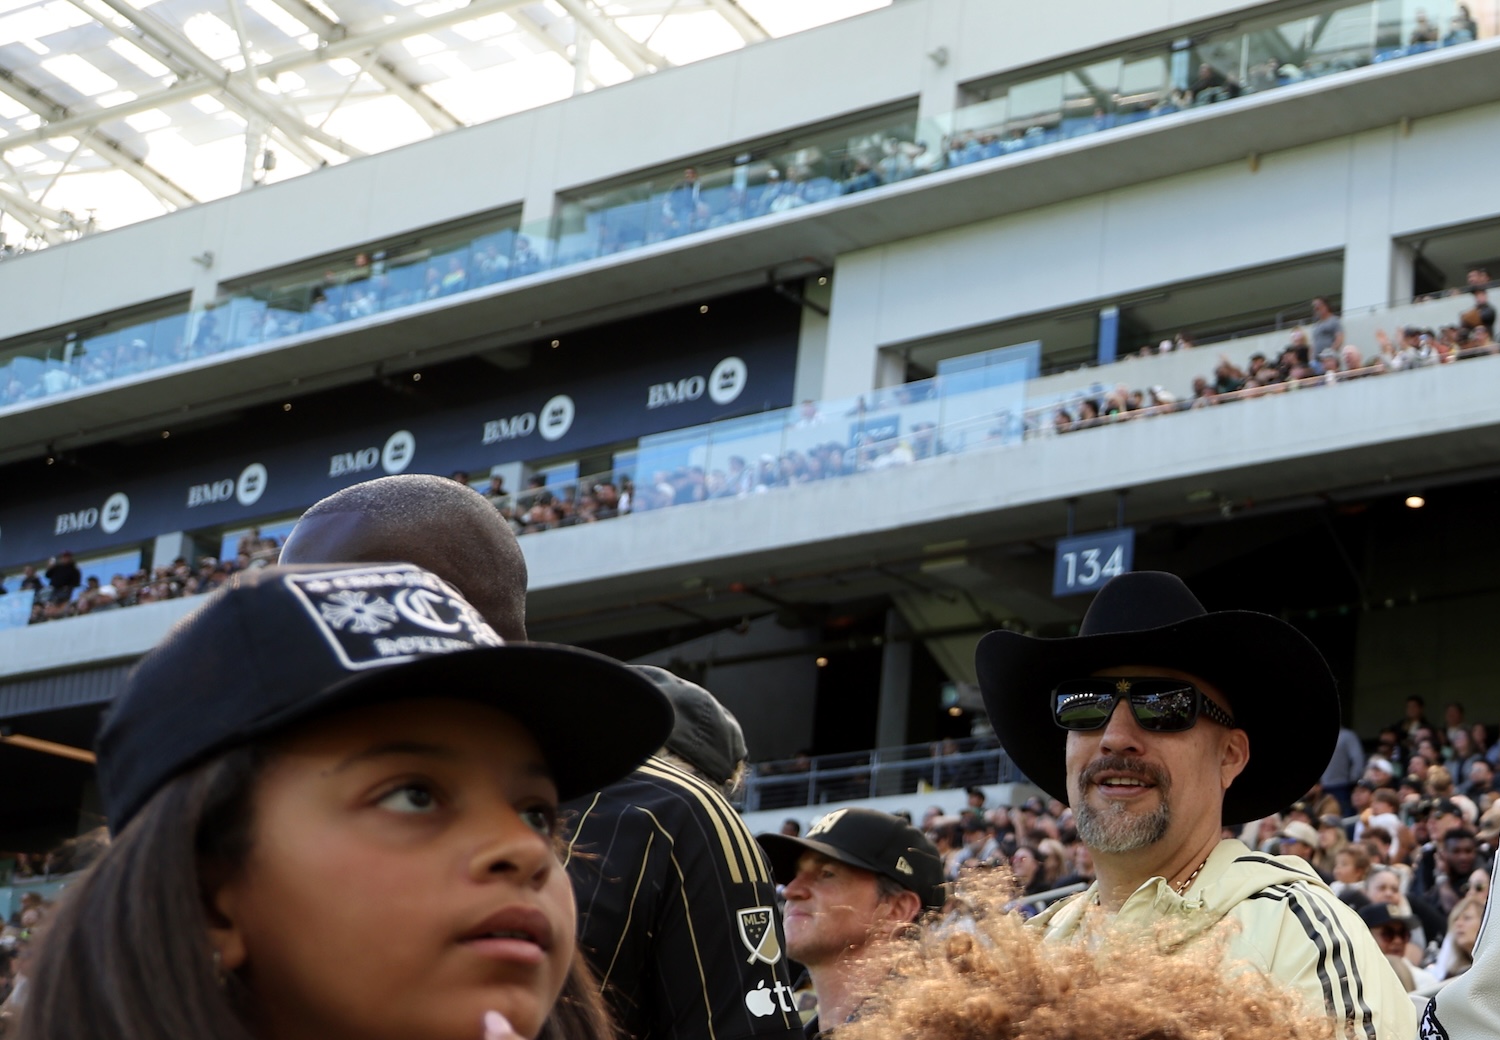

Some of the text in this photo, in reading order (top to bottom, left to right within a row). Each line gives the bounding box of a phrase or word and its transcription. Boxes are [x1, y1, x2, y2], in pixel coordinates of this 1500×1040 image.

[647, 375, 706, 411] BMO
[482, 411, 537, 446] BMO
[329, 446, 381, 478] BMO
[187, 478, 235, 509] BMO
[54, 507, 99, 536] BMO
[1063, 545, 1124, 589] 134
[743, 912, 767, 926] MLS
